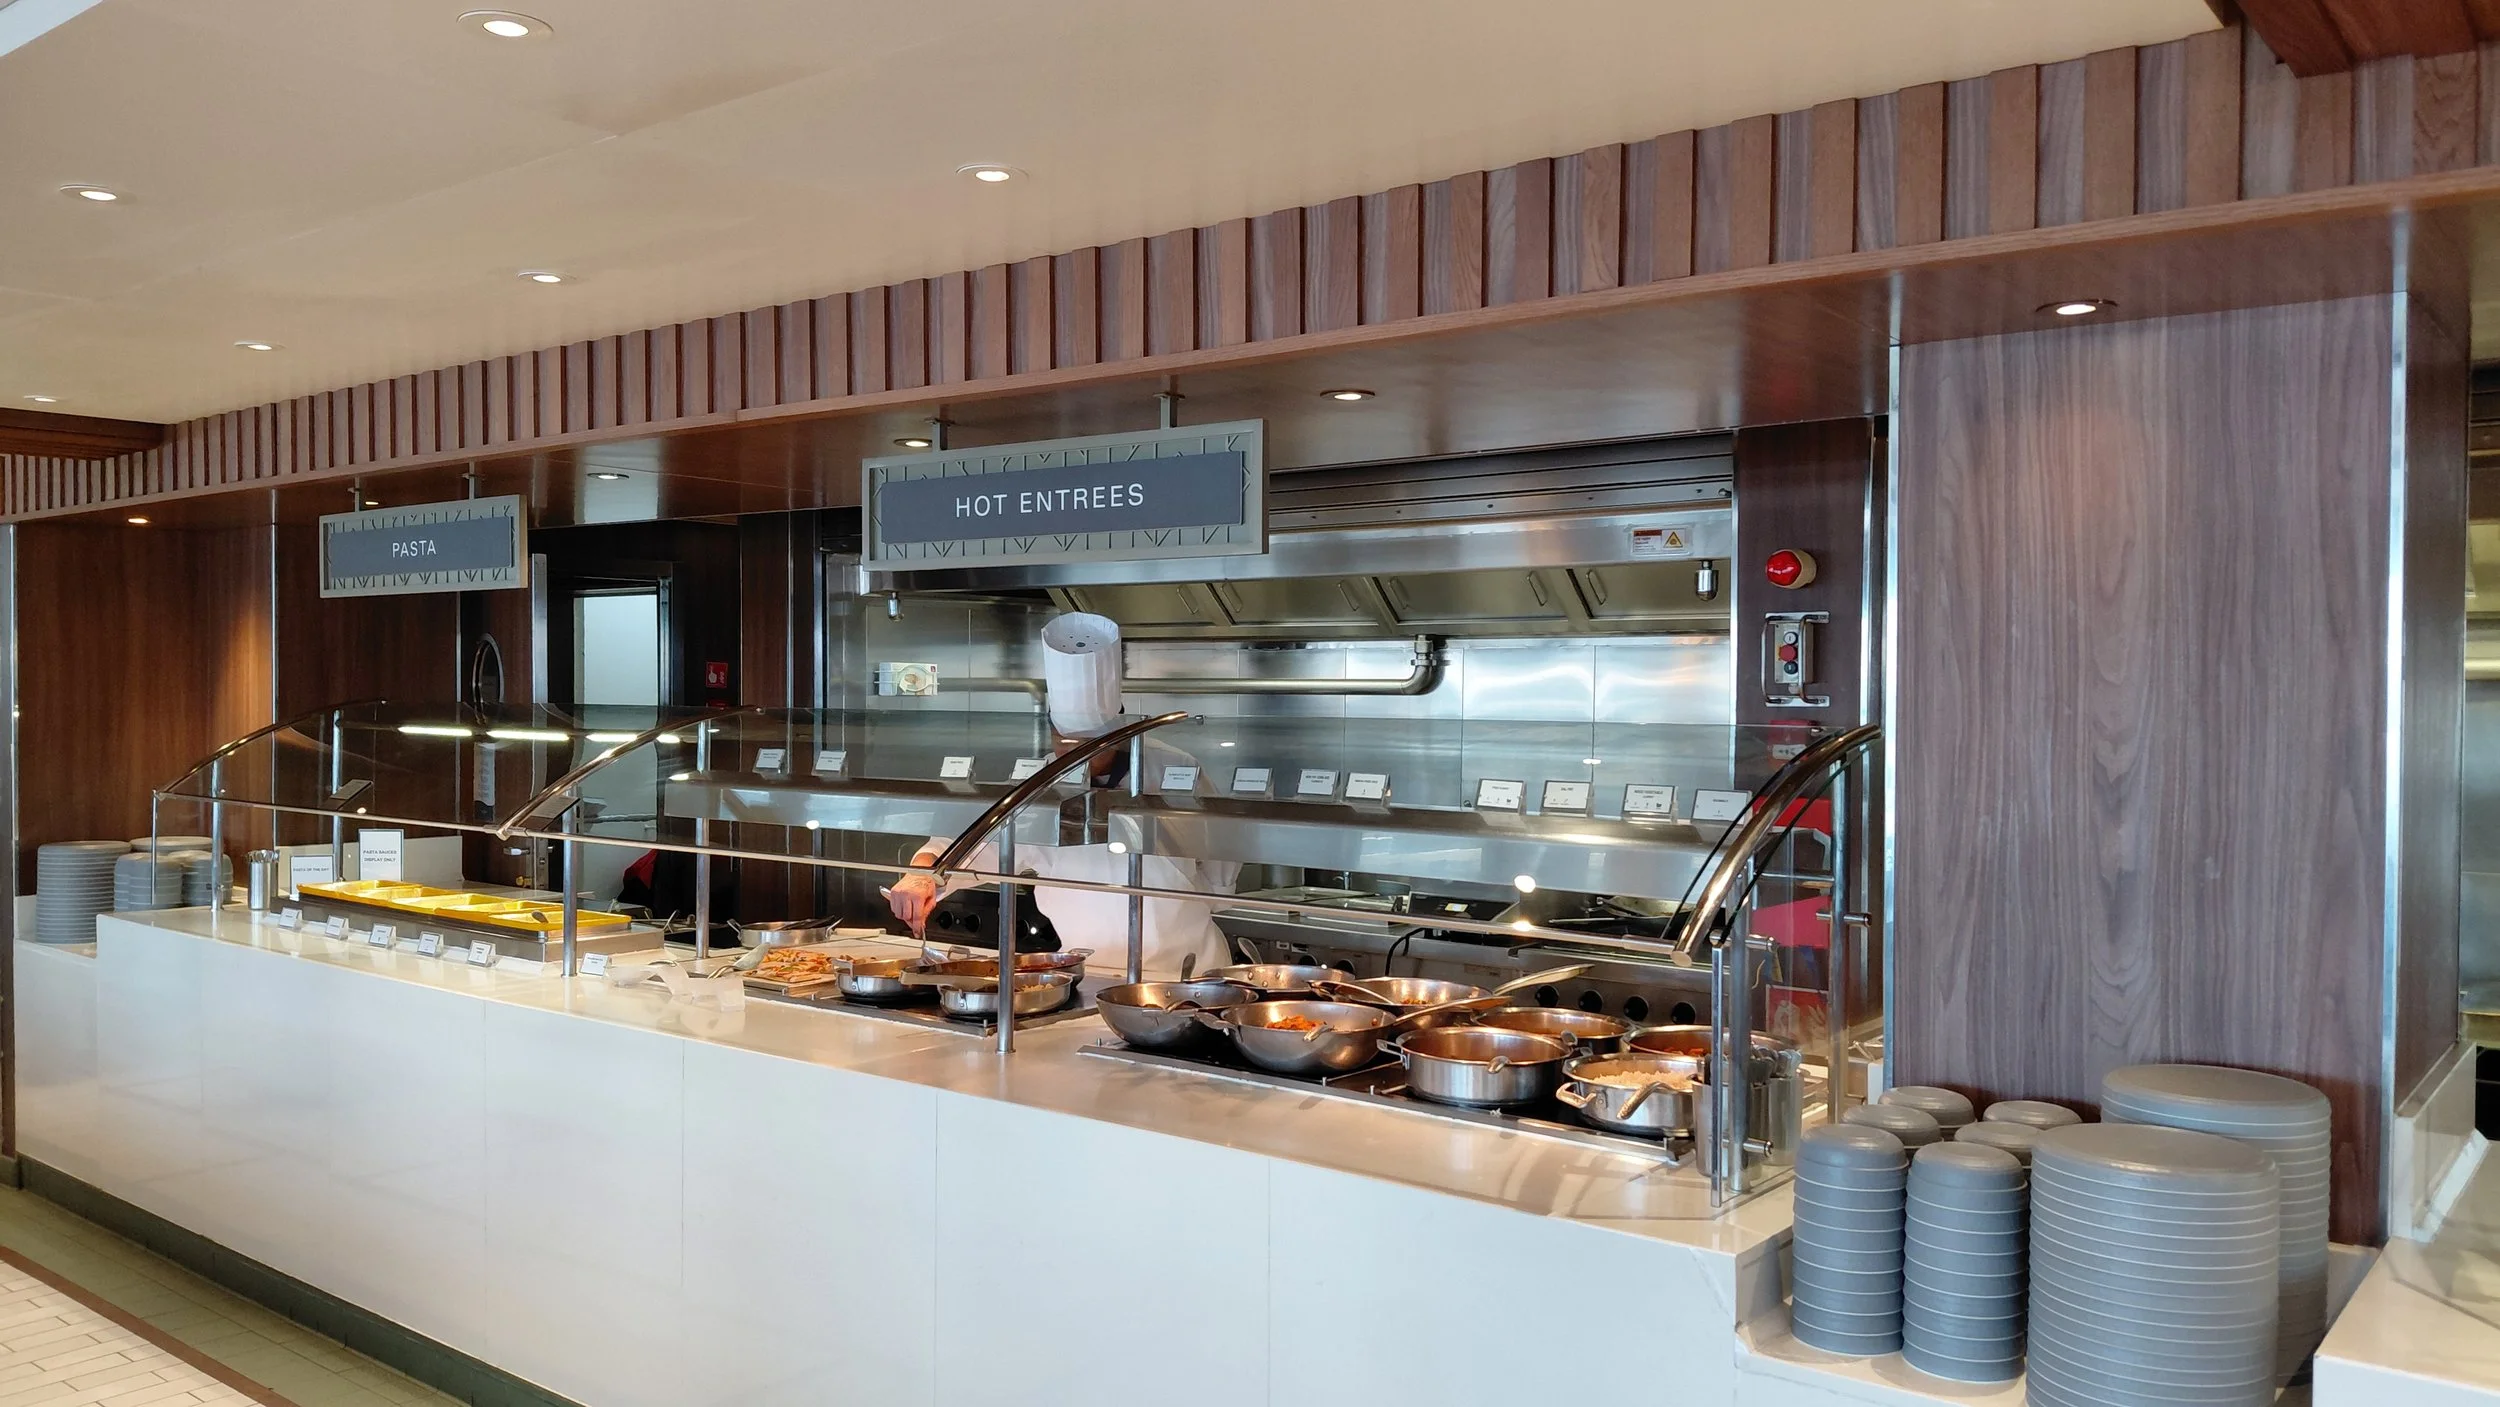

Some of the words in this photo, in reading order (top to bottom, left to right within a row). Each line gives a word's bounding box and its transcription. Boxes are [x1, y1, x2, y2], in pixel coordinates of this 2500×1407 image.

[955, 494, 1009, 518] HOT
[1019, 483, 1145, 514] ENTREES
[392, 539, 437, 558] PASTA
